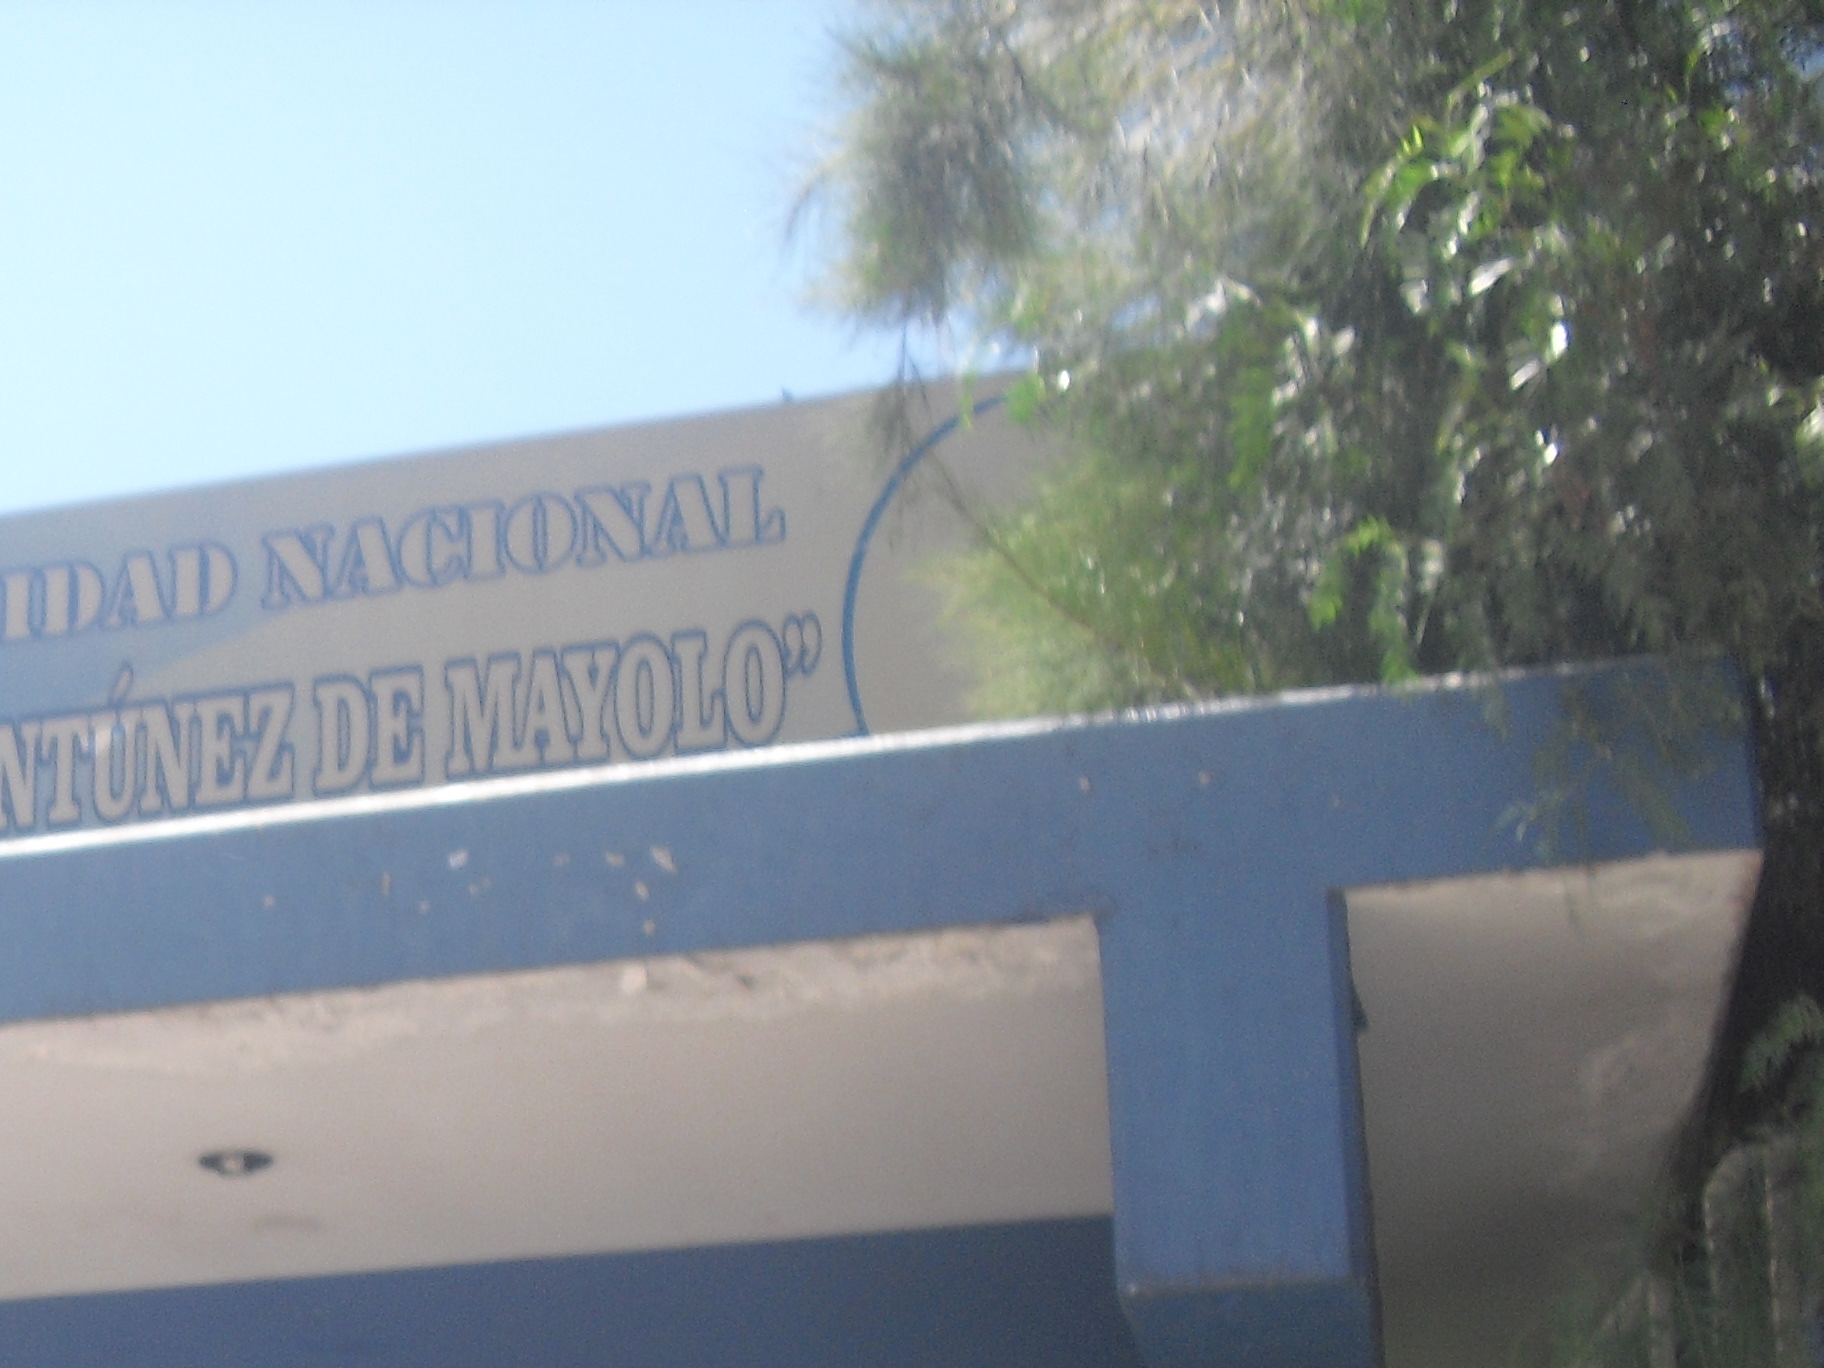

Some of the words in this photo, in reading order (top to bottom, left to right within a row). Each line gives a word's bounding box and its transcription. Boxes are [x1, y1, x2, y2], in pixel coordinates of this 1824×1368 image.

[261, 465, 787, 609] NACIONAL
[313, 666, 425, 797] DE
[444, 612, 823, 780] MAYOLO”
